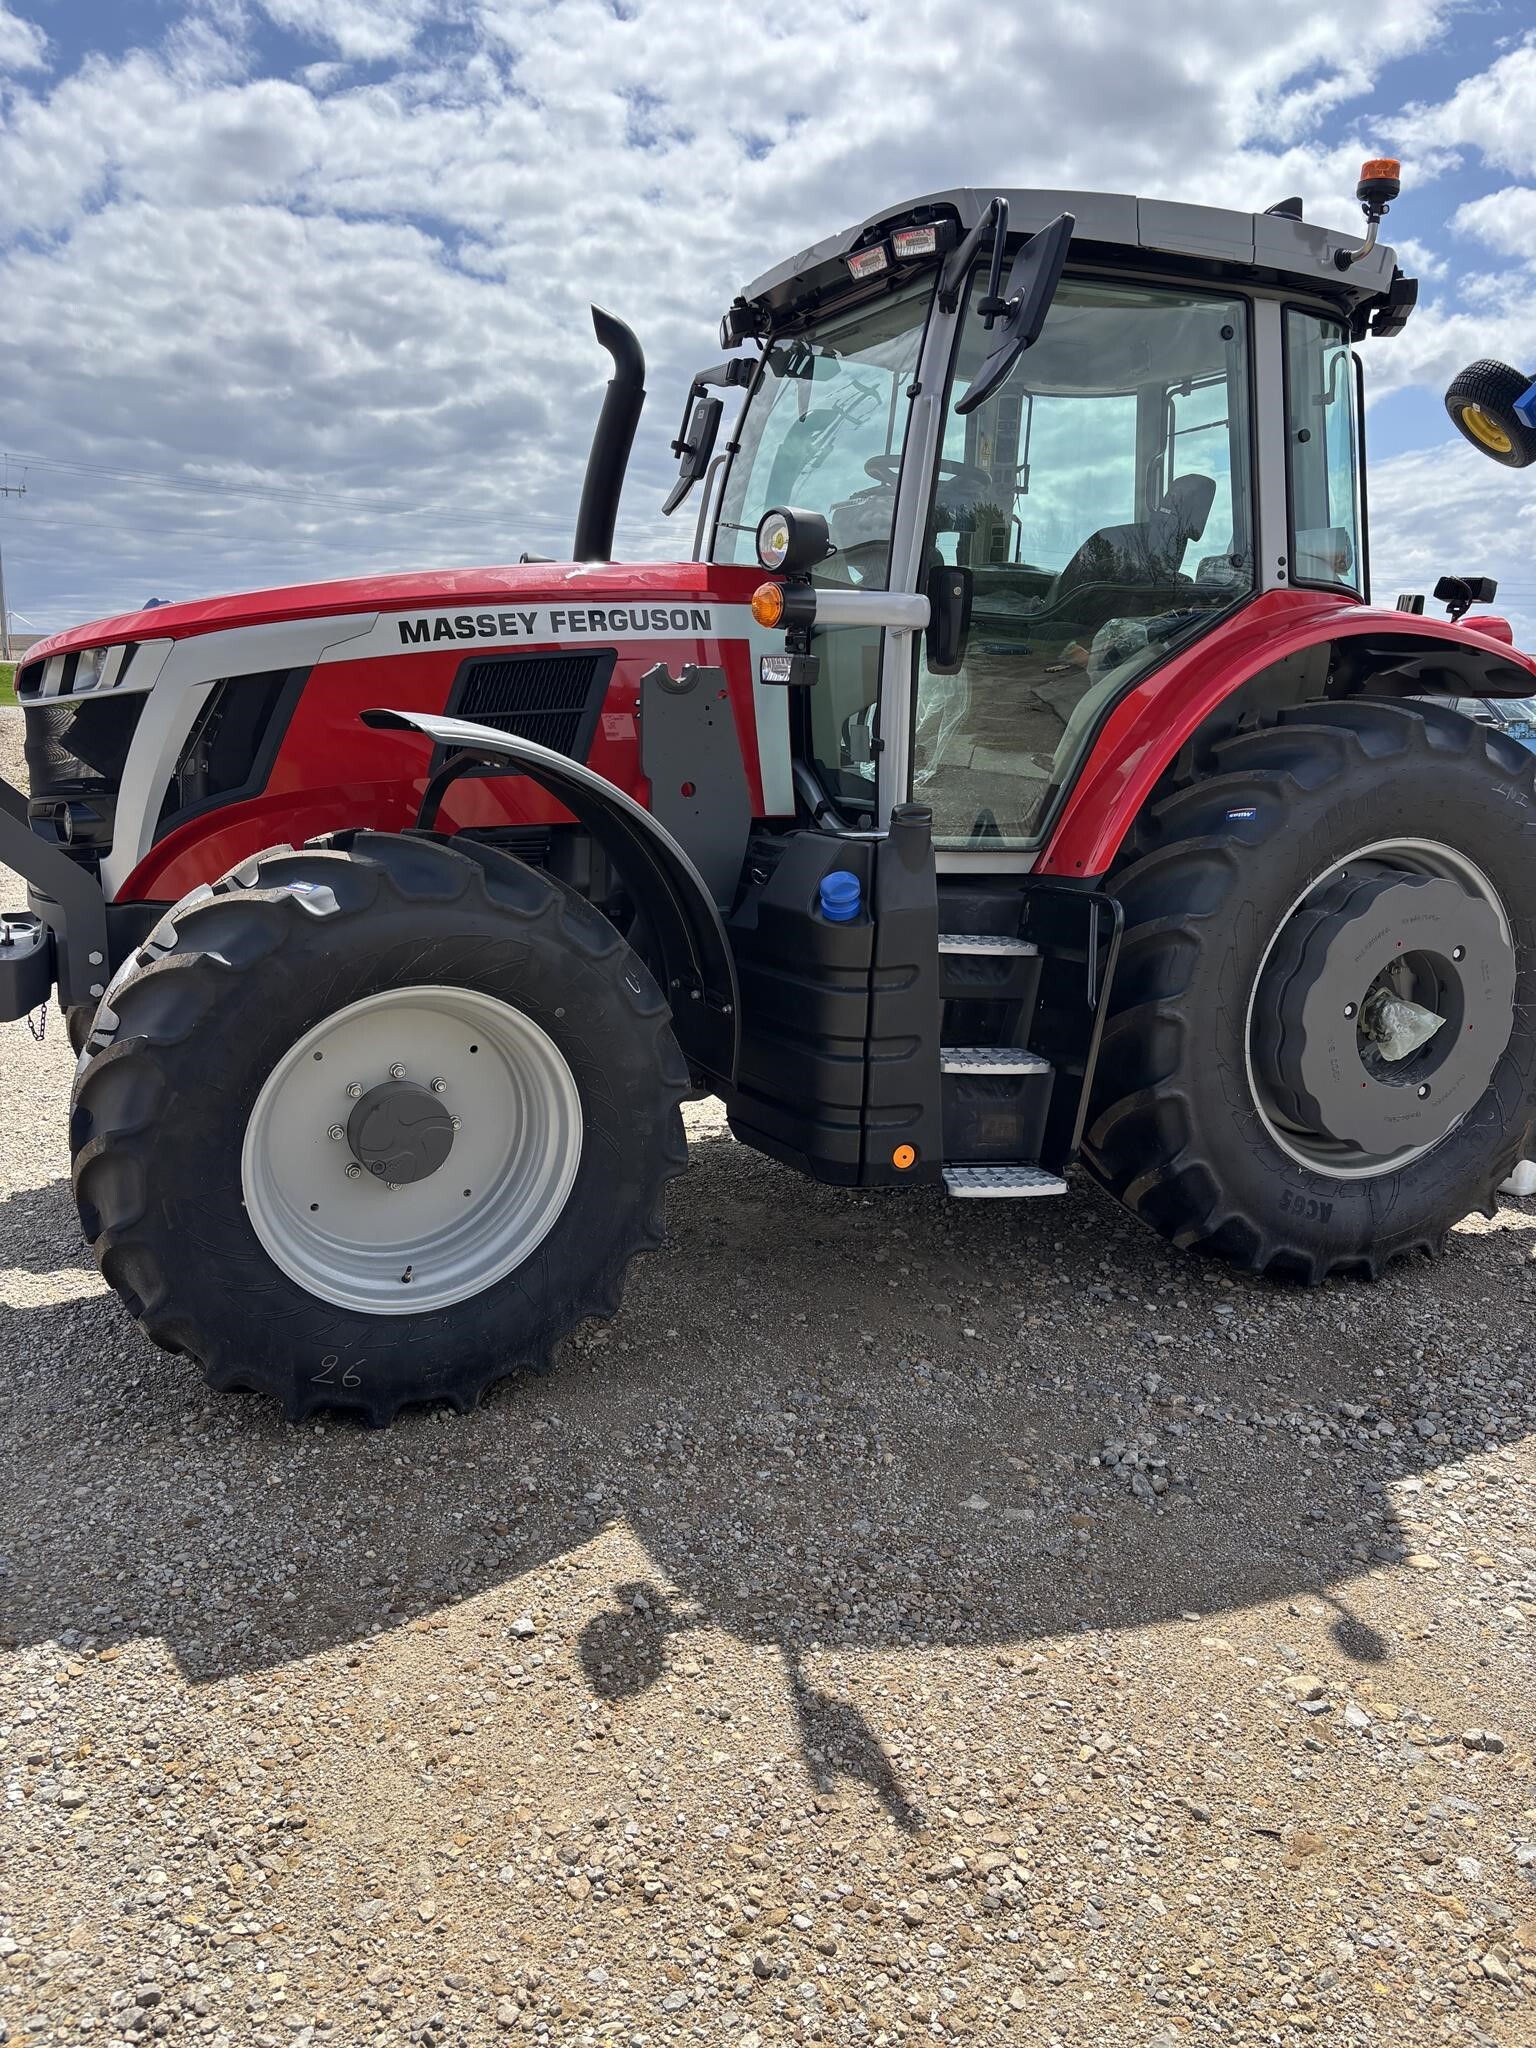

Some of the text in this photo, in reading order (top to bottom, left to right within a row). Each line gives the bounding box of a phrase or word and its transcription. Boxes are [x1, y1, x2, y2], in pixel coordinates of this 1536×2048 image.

[398, 609, 712, 645] MASSEY FERGUSON
[310, 1354, 367, 1388] 26
